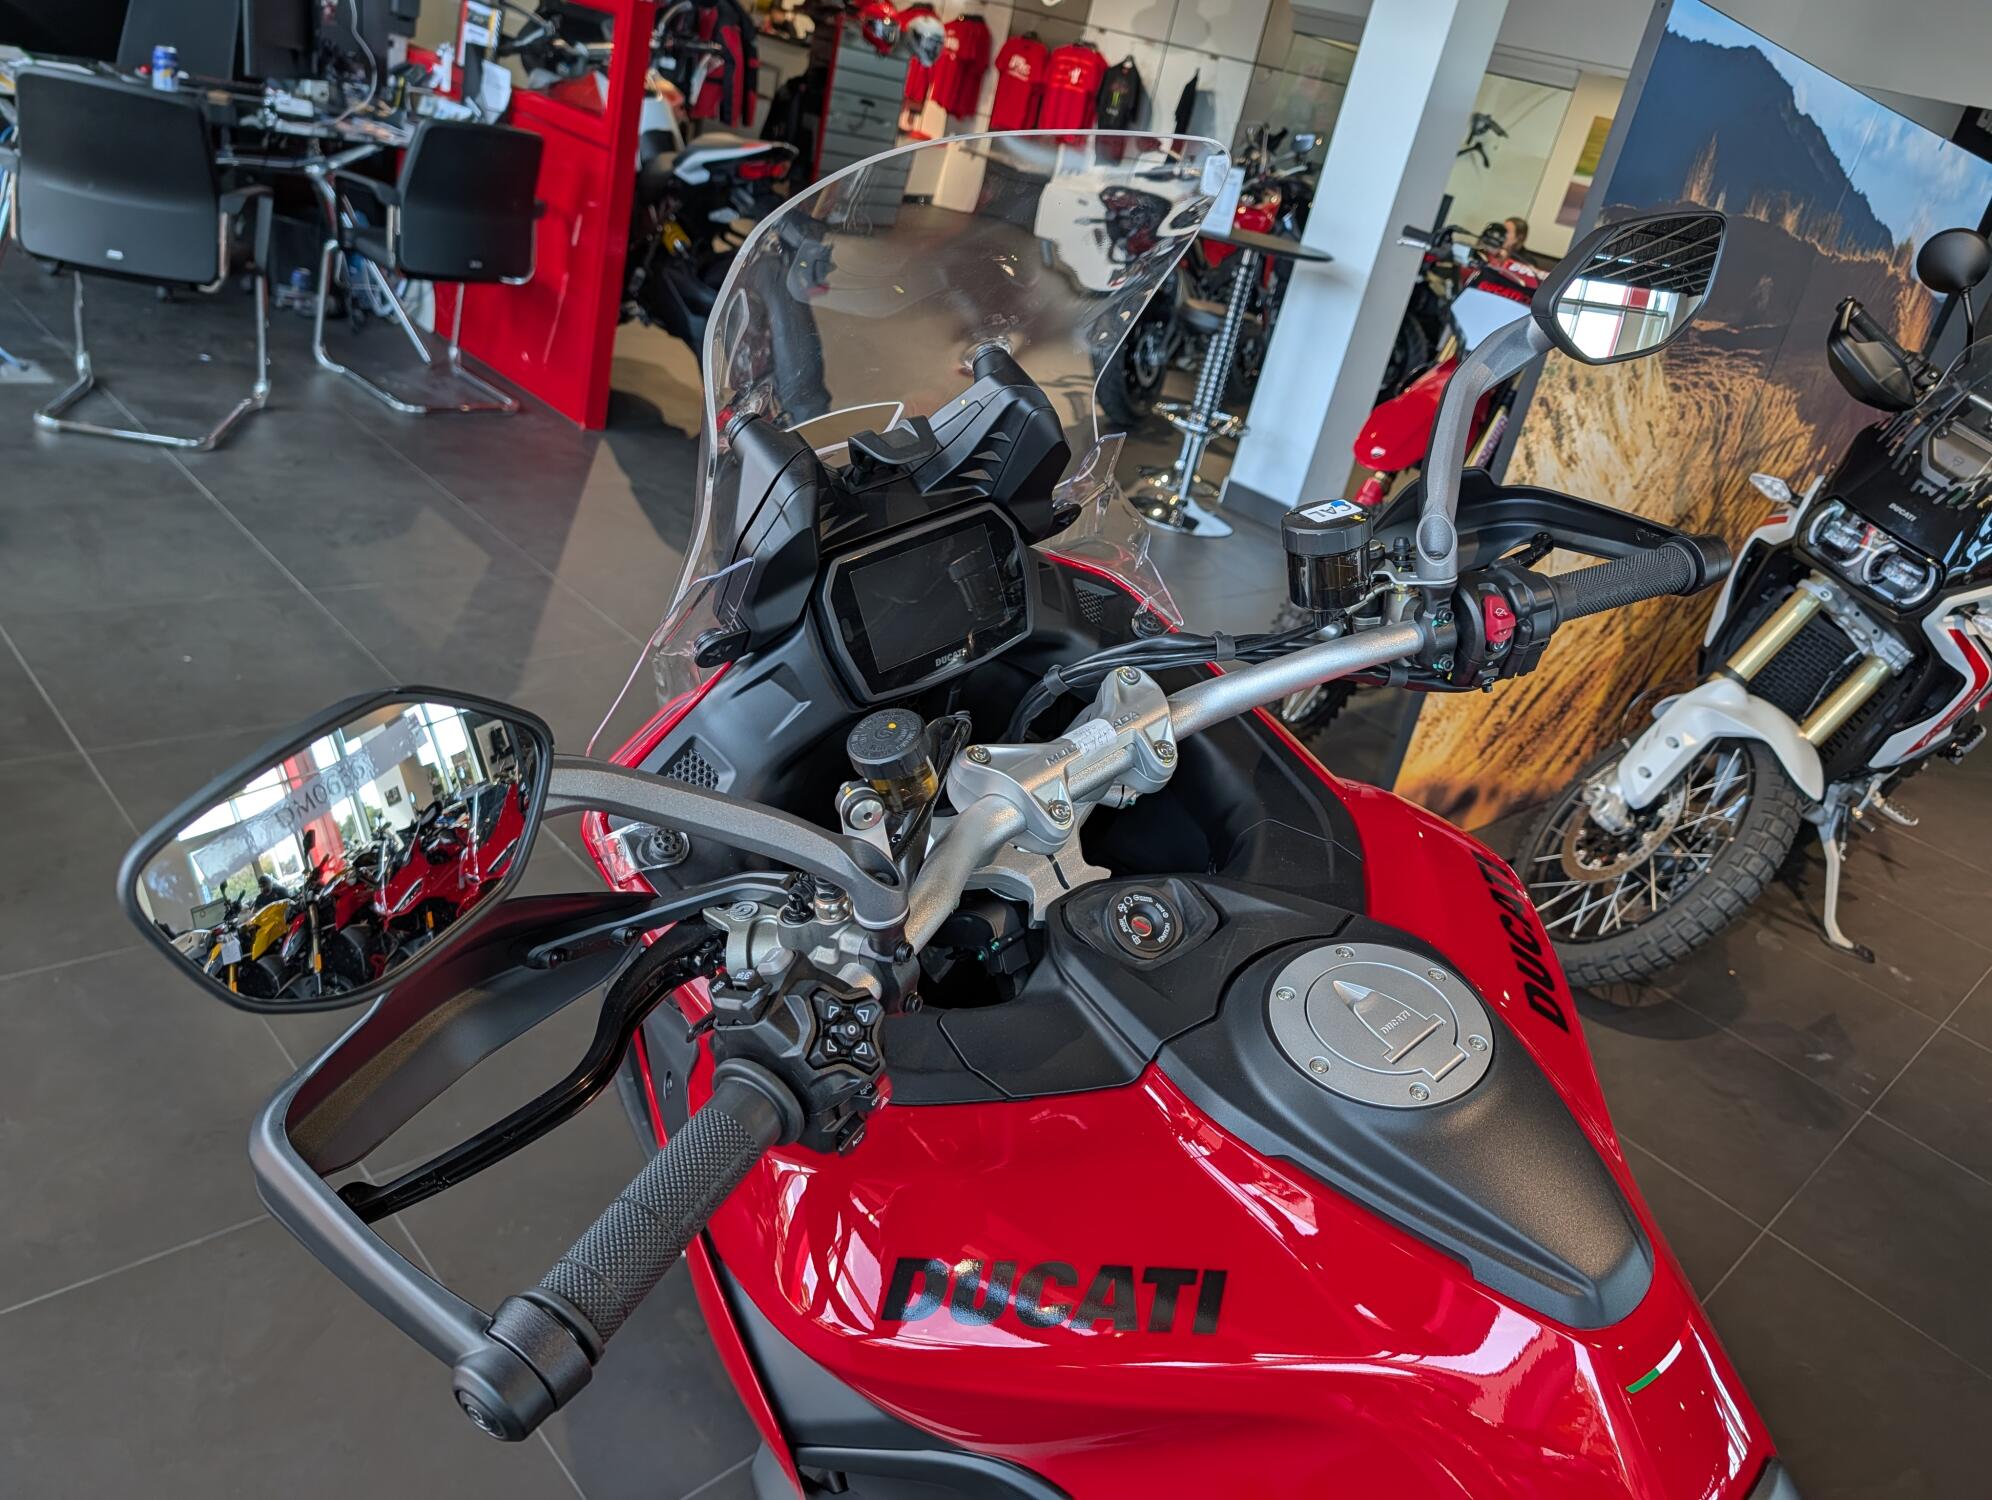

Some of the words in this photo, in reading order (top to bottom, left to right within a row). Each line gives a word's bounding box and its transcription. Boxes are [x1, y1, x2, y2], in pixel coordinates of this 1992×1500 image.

[1888, 502, 1917, 522] DUCATI
[1471, 849, 1570, 1034] DUCATI
[1380, 1009, 1411, 1035] DUCATI
[880, 1257, 1228, 1336] DUCATI
